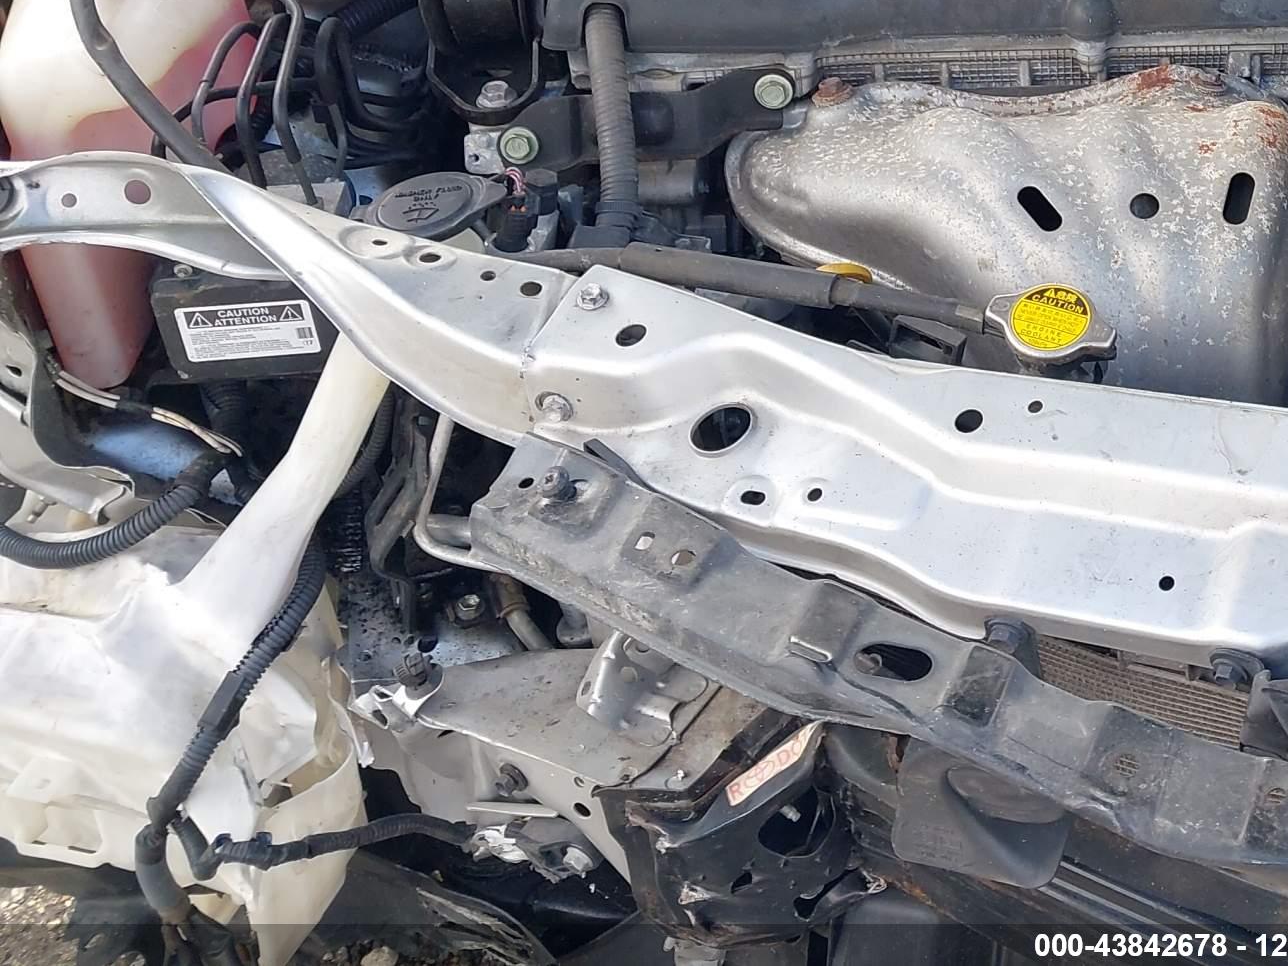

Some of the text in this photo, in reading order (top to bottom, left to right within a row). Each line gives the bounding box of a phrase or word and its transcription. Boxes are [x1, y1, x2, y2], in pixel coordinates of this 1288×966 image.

[1032, 294, 1084, 313] CAUTION
[217, 307, 270, 319] CAUTION
[214, 315, 277, 327] ATTENTION
[1020, 329, 1062, 344] COOLANT
[1025, 324, 1062, 338] ENGINE
